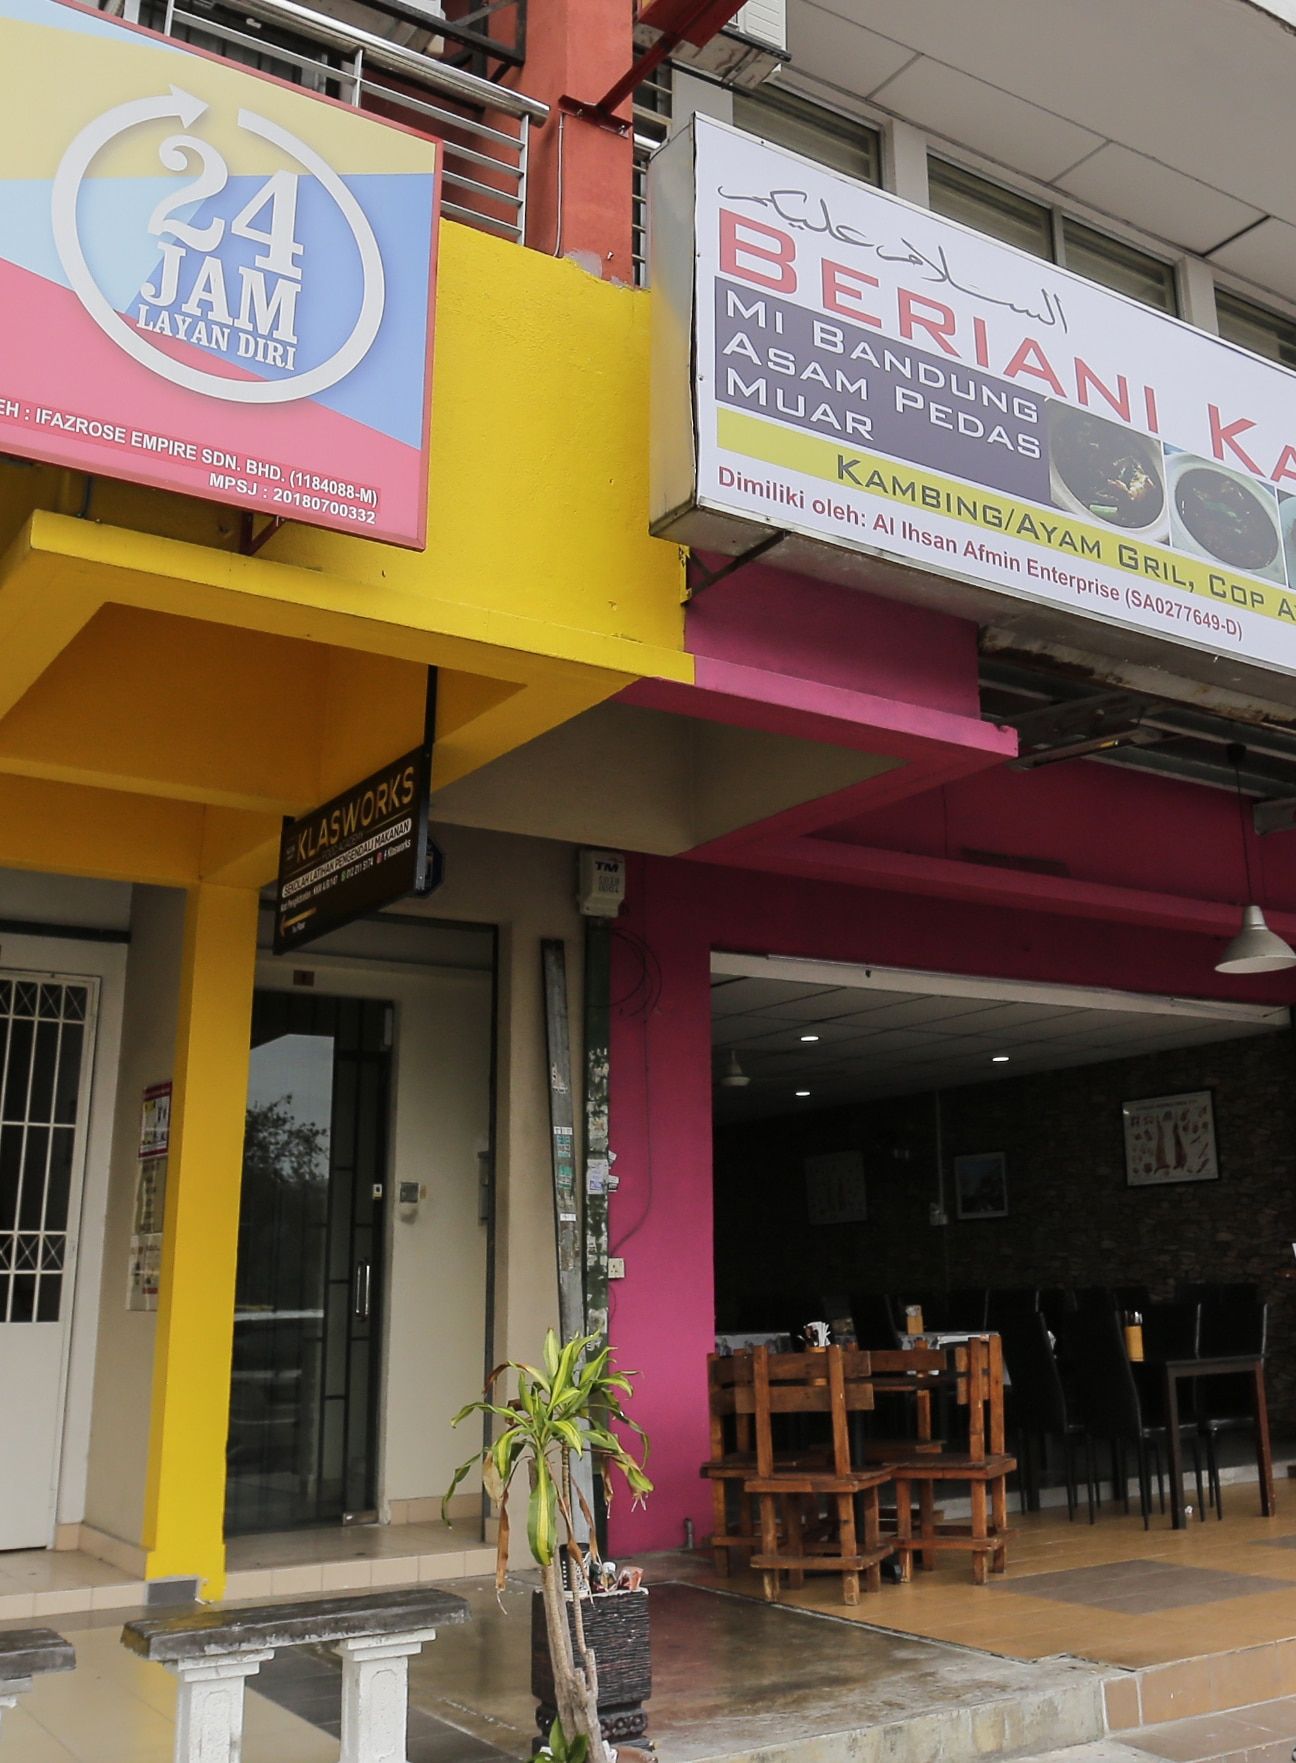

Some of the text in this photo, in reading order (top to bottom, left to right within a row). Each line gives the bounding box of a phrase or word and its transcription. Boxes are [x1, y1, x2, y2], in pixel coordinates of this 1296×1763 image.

[148, 134, 304, 280] 24
[136, 303, 297, 371] LAYAN DIRI
[140, 241, 302, 344] JAM
[719, 207, 1159, 434] BERIANI
[722, 331, 1042, 460] ASAM PEDAS
[726, 289, 1039, 423] MI BANDUNG
[726, 366, 875, 441] MUAR
[35, 407, 126, 444] IFAZROSE
[131, 431, 197, 461] EMPIRE
[201, 449, 241, 472] SDN.
[246, 459, 286, 483] BHD.
[289, 469, 378, 508] (1184088-M)
[208, 472, 257, 497] MPSJ
[273, 487, 375, 525] 20180700332
[718, 465, 1243, 642] Dimiliki oleh: Al Ihsan Afmin Enterprise (SA0277649-D)
[836, 453, 1103, 560] KAMBING/AYAM
[1118, 543, 1195, 593] GRIL,
[1208, 573, 1265, 609] COP
[296, 765, 415, 865] KLASWORKS
[373, 820, 410, 851] MAKANAN
